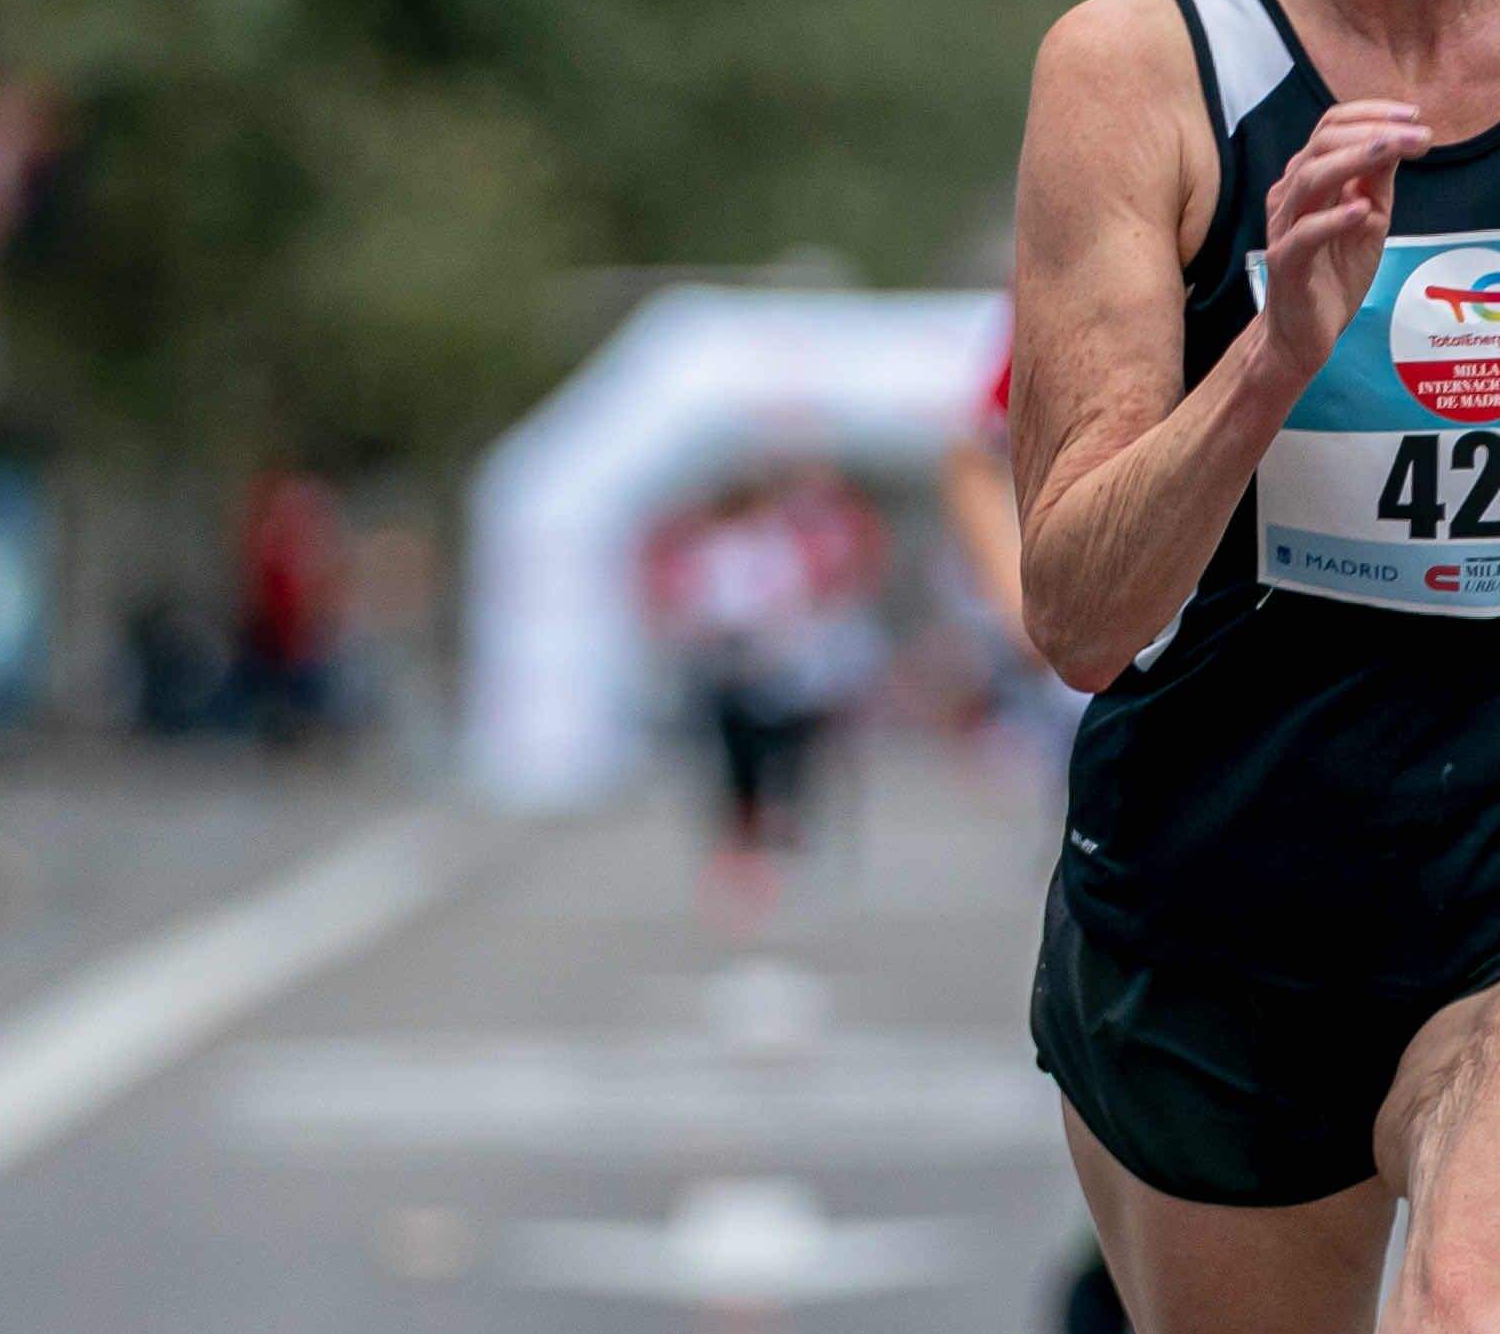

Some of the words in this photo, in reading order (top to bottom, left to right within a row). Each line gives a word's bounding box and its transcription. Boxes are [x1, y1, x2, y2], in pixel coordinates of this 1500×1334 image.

[1453, 363, 1500, 378] MILLA
[1436, 396, 1459, 410] DE
[1305, 552, 1399, 582] MADRID
